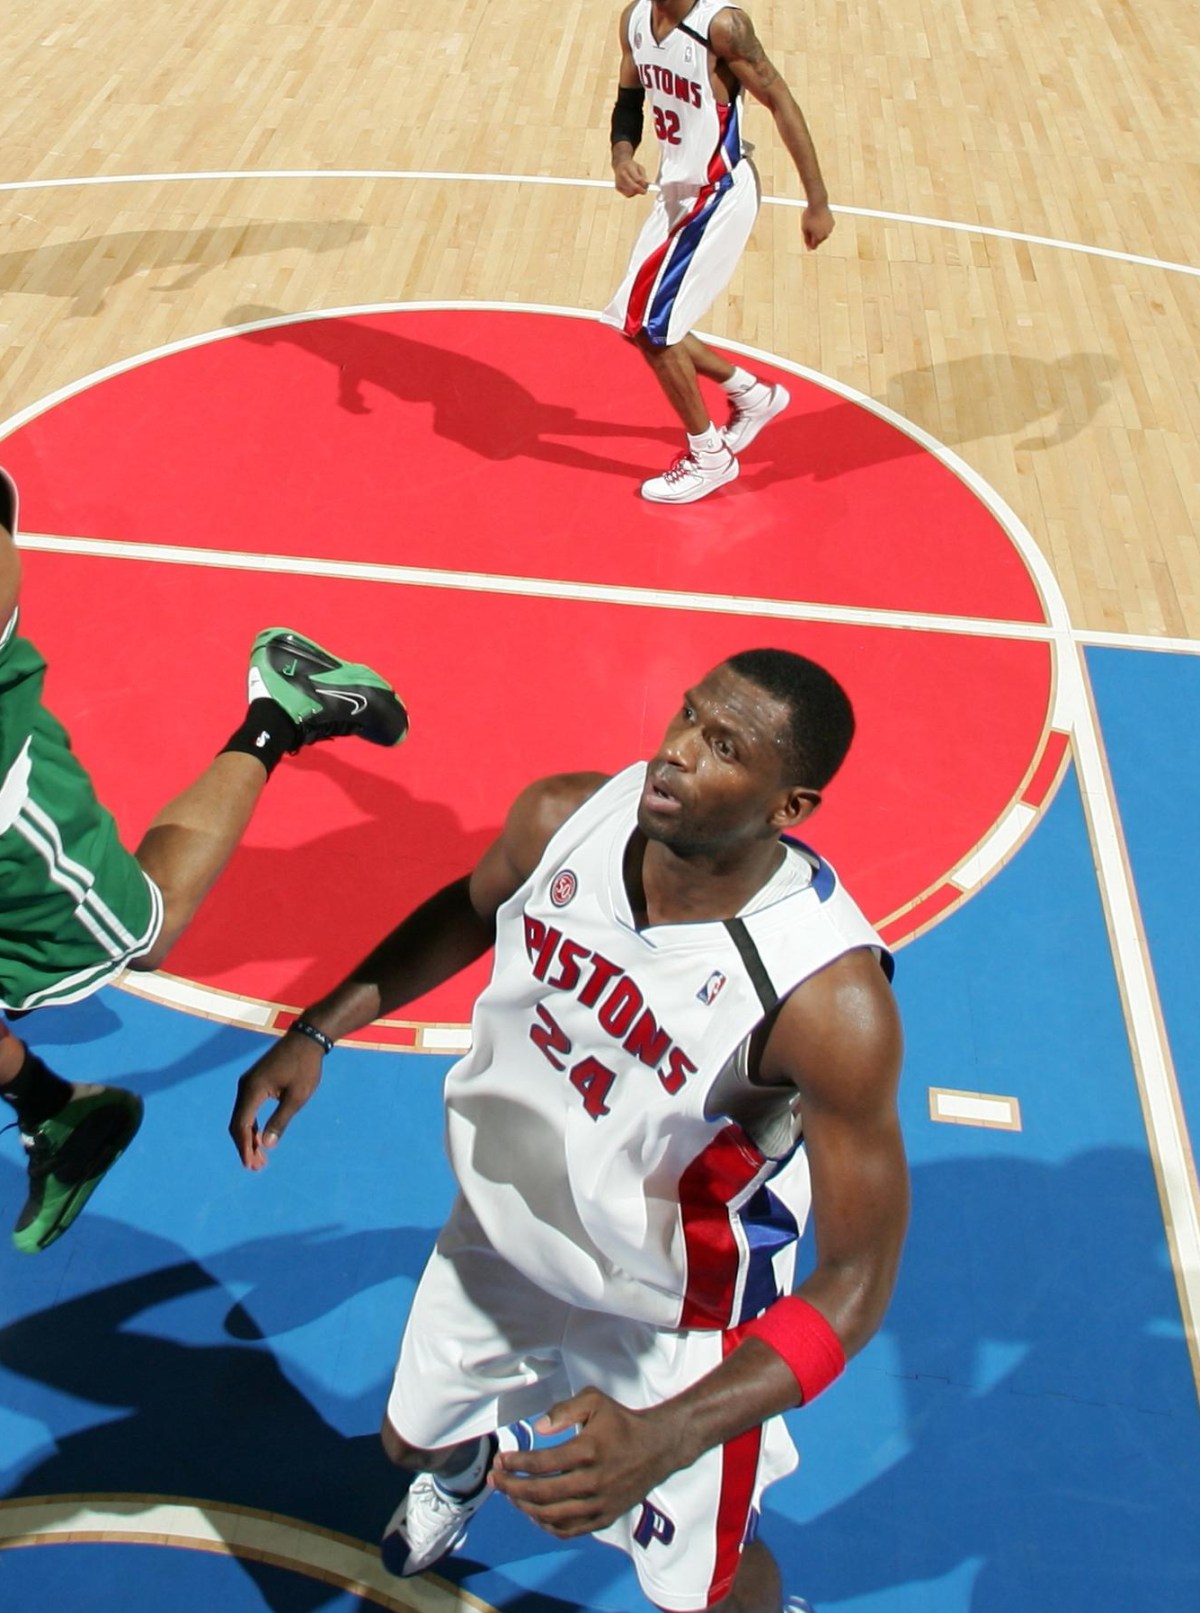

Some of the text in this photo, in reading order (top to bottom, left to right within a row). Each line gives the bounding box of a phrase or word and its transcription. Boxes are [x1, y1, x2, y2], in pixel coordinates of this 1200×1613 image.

[653, 105, 682, 145] 32
[524, 914, 699, 1096] PISTONS
[529, 1001, 617, 1122] 24
